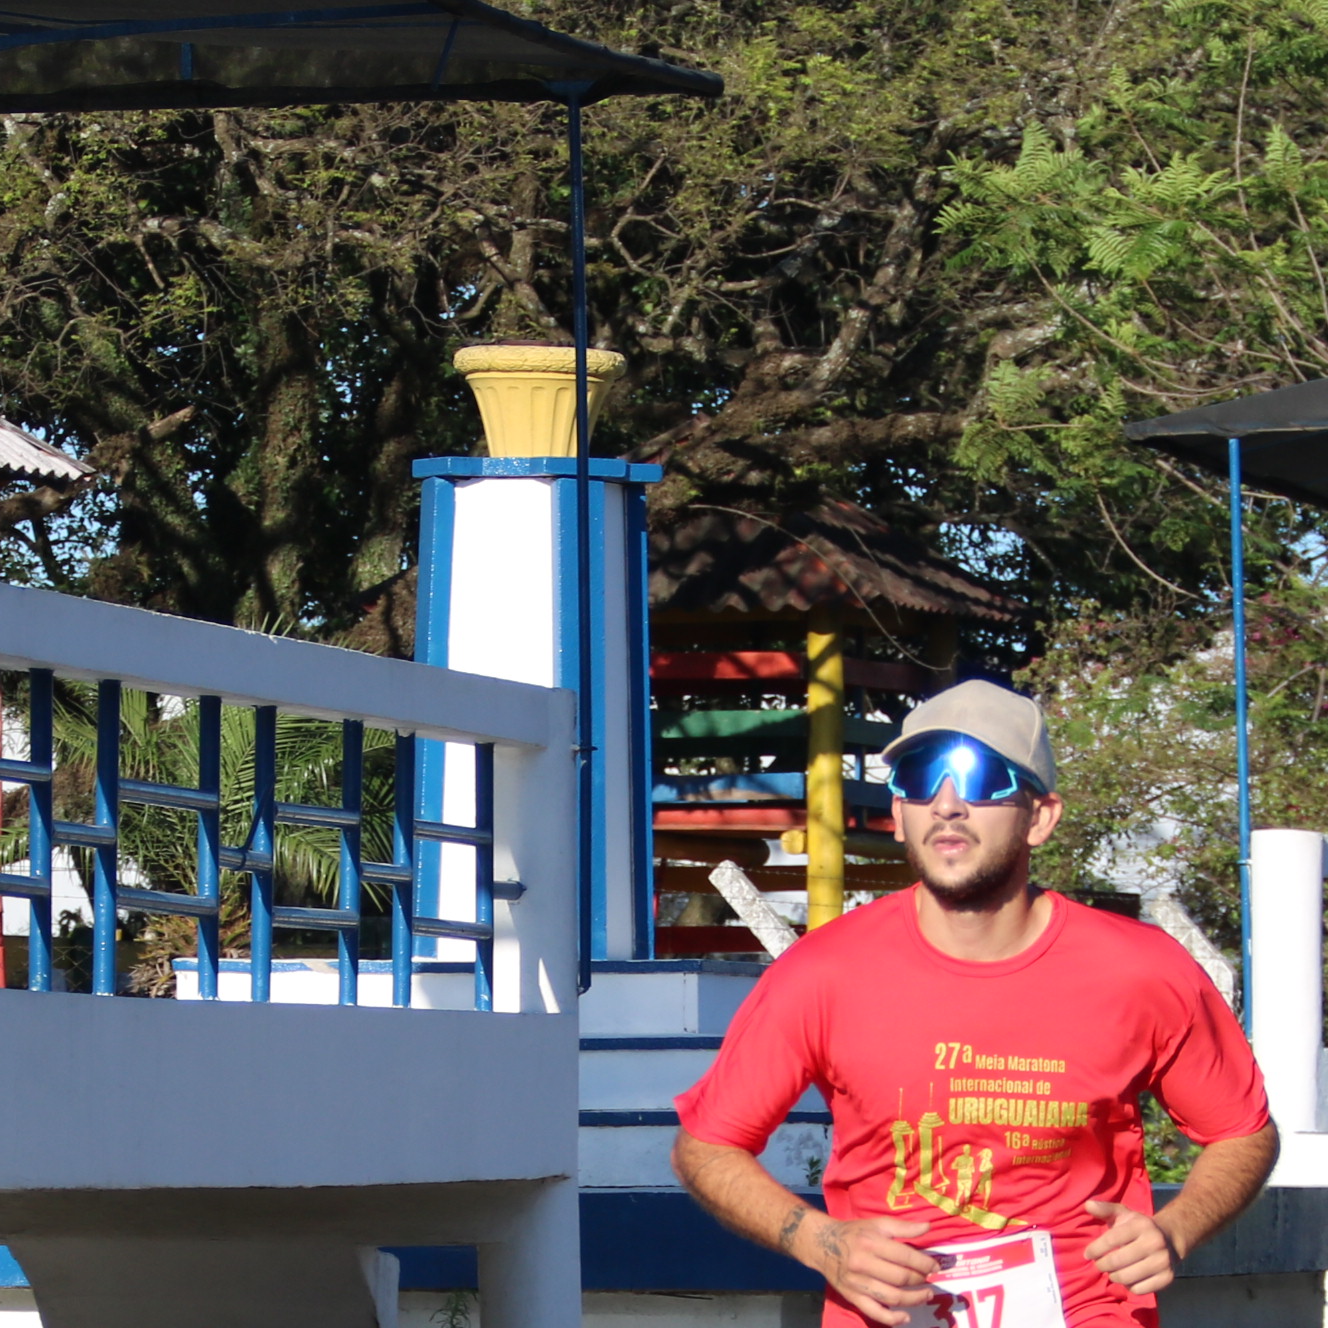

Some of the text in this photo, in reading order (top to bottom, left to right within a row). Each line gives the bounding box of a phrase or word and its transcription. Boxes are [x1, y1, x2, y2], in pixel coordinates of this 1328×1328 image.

[975, 1054, 1005, 1070] Meia
[1008, 1056, 1065, 1073] Maratona
[950, 1077, 1051, 1095] Internacional de
[948, 1097, 1088, 1128] URUGUAIANA
